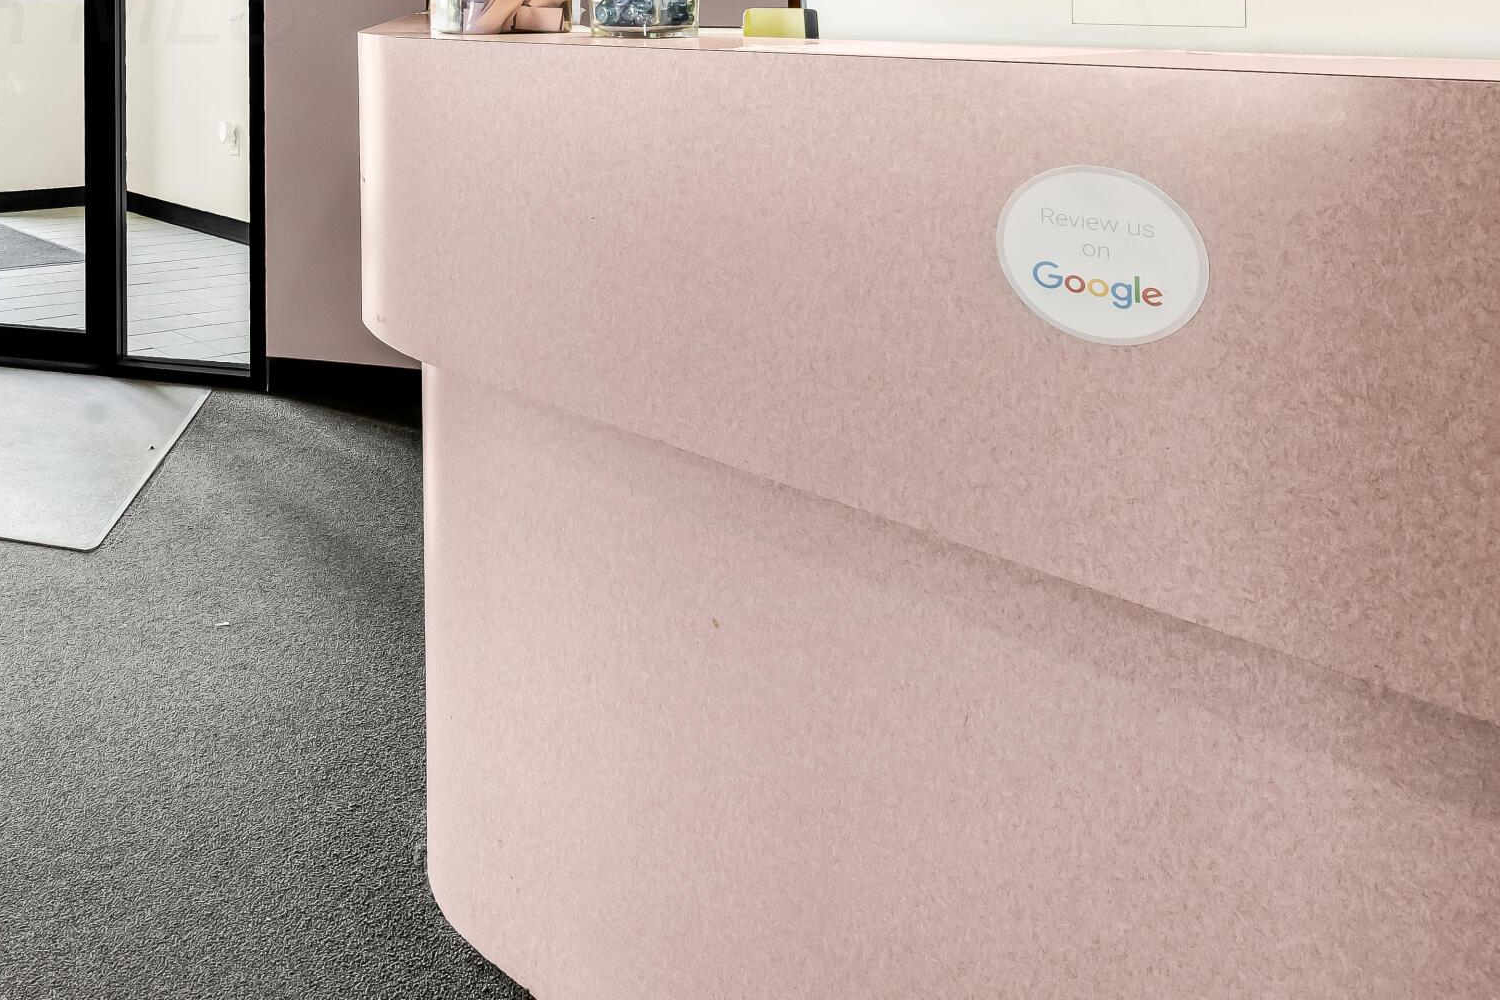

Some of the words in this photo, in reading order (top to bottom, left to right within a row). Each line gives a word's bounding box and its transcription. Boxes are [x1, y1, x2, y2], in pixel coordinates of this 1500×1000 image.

[1040, 207, 1118, 233] Review
[1127, 223, 1155, 238] us
[1082, 243, 1110, 259] on
[1032, 260, 1163, 310] Google
